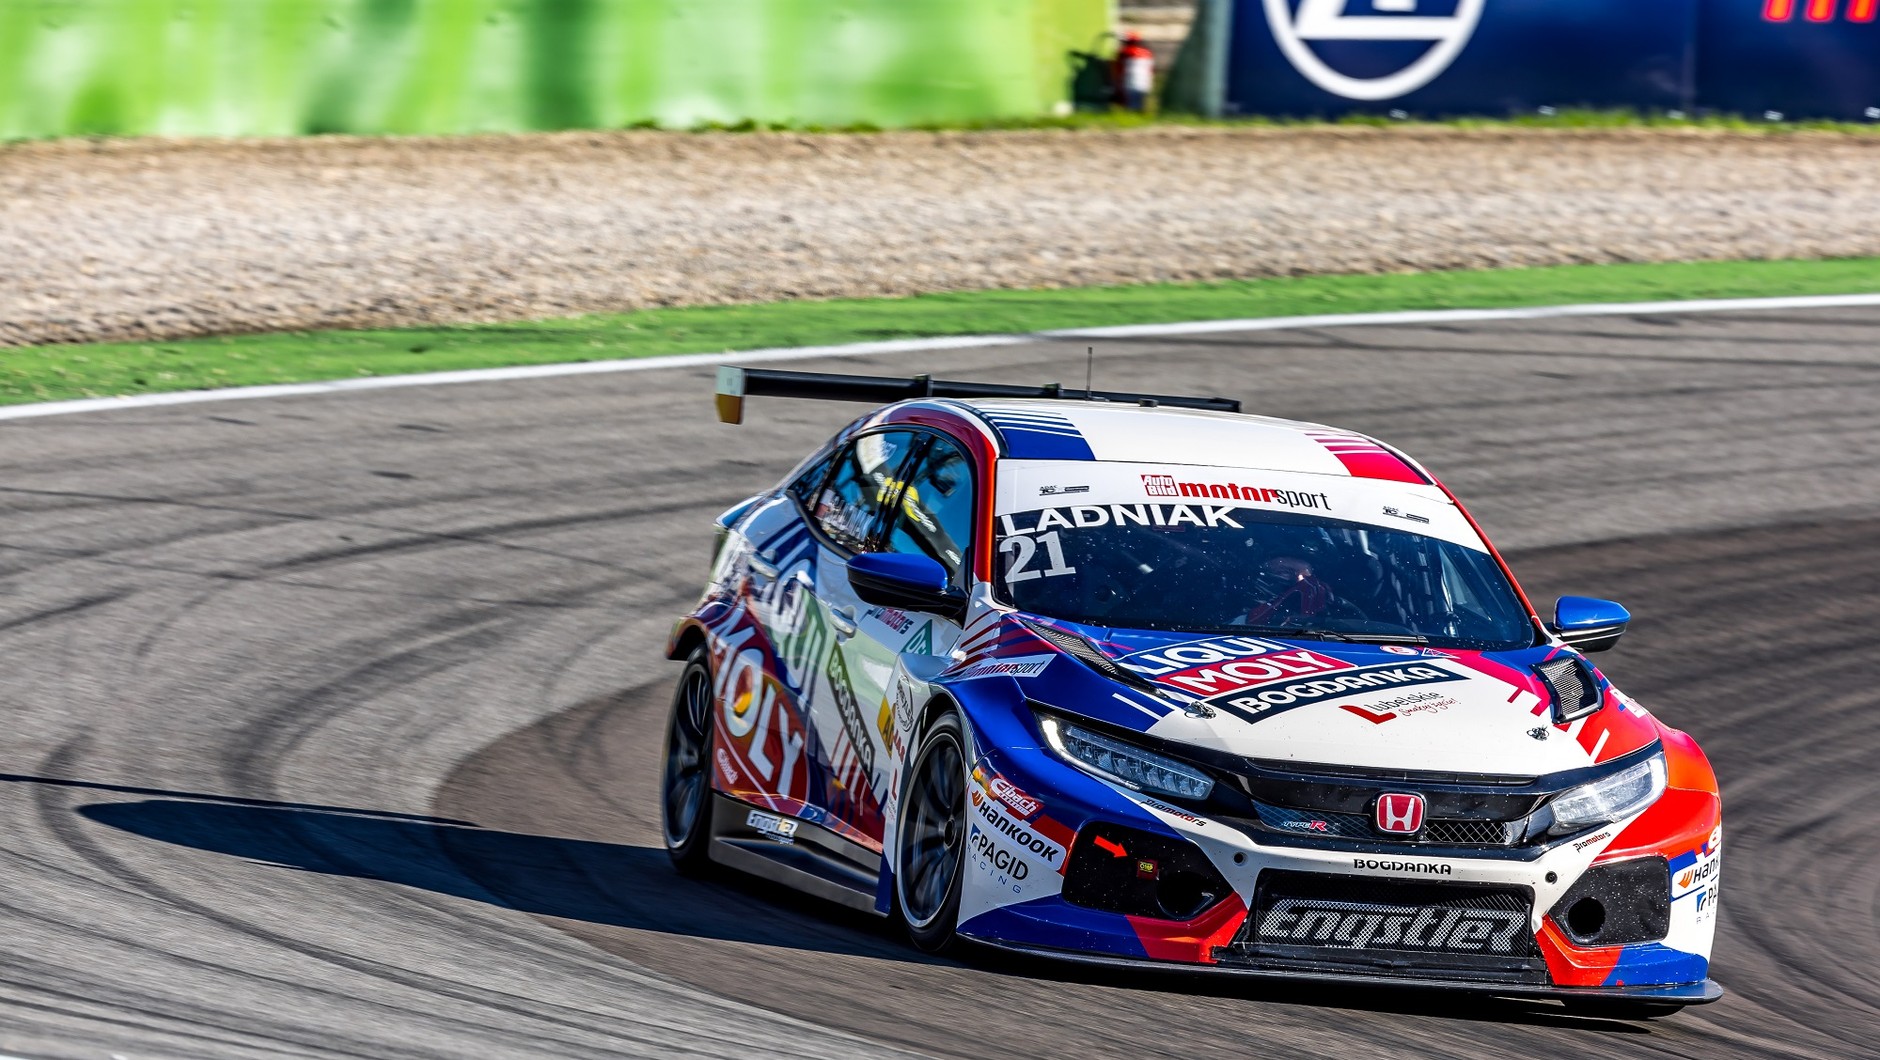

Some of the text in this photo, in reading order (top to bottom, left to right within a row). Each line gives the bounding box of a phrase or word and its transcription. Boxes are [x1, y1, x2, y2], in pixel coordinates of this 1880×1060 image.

[1143, 475, 1173, 485] Auto
[1147, 485, 1179, 496] Bild
[1179, 482, 1332, 511] motorsport
[1001, 504, 1245, 537] LADNIAK
[999, 531, 1077, 583] 21
[1118, 636, 1288, 676] LIQUI
[1169, 650, 1340, 693] MOLY
[710, 600, 804, 799] MOLY
[1227, 666, 1450, 715] BOGDANKA
[991, 778, 1038, 814] Eibach
[967, 844, 1022, 893] RACING
[977, 833, 1029, 880] PAGID
[1353, 858, 1452, 875] BOGDANKA
[1259, 899, 1526, 951] Engstler
